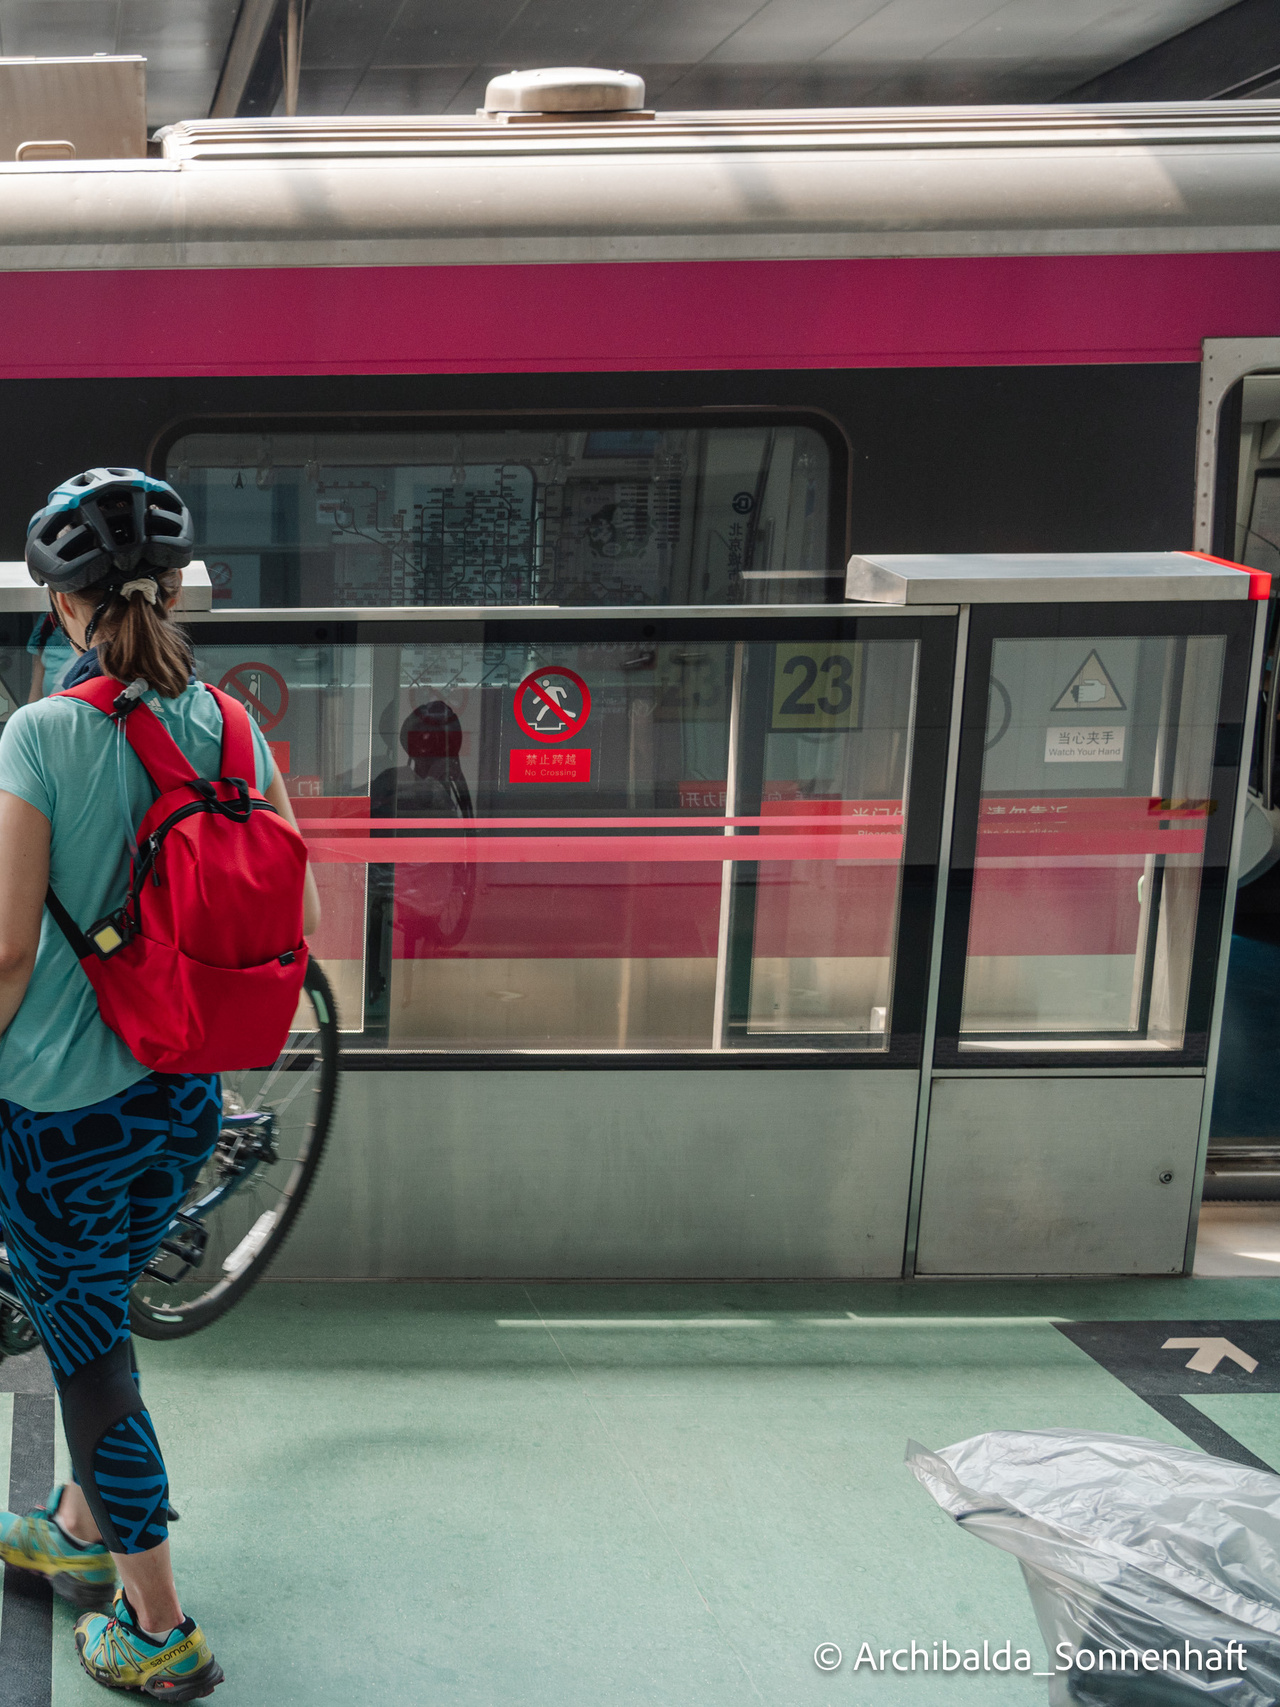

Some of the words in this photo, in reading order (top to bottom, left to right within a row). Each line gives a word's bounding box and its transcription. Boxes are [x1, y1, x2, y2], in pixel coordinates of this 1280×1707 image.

[778, 655, 853, 715] 23
[1058, 730, 1115, 745] 当心夹手
[1048, 748, 1075, 756] Watch
[1077, 748, 1096, 756] Your
[1098, 747, 1121, 755] Hand
[525, 753, 577, 766] 禁止跨越
[524, 769, 537, 777] No
[540, 768, 577, 778] Crossing
